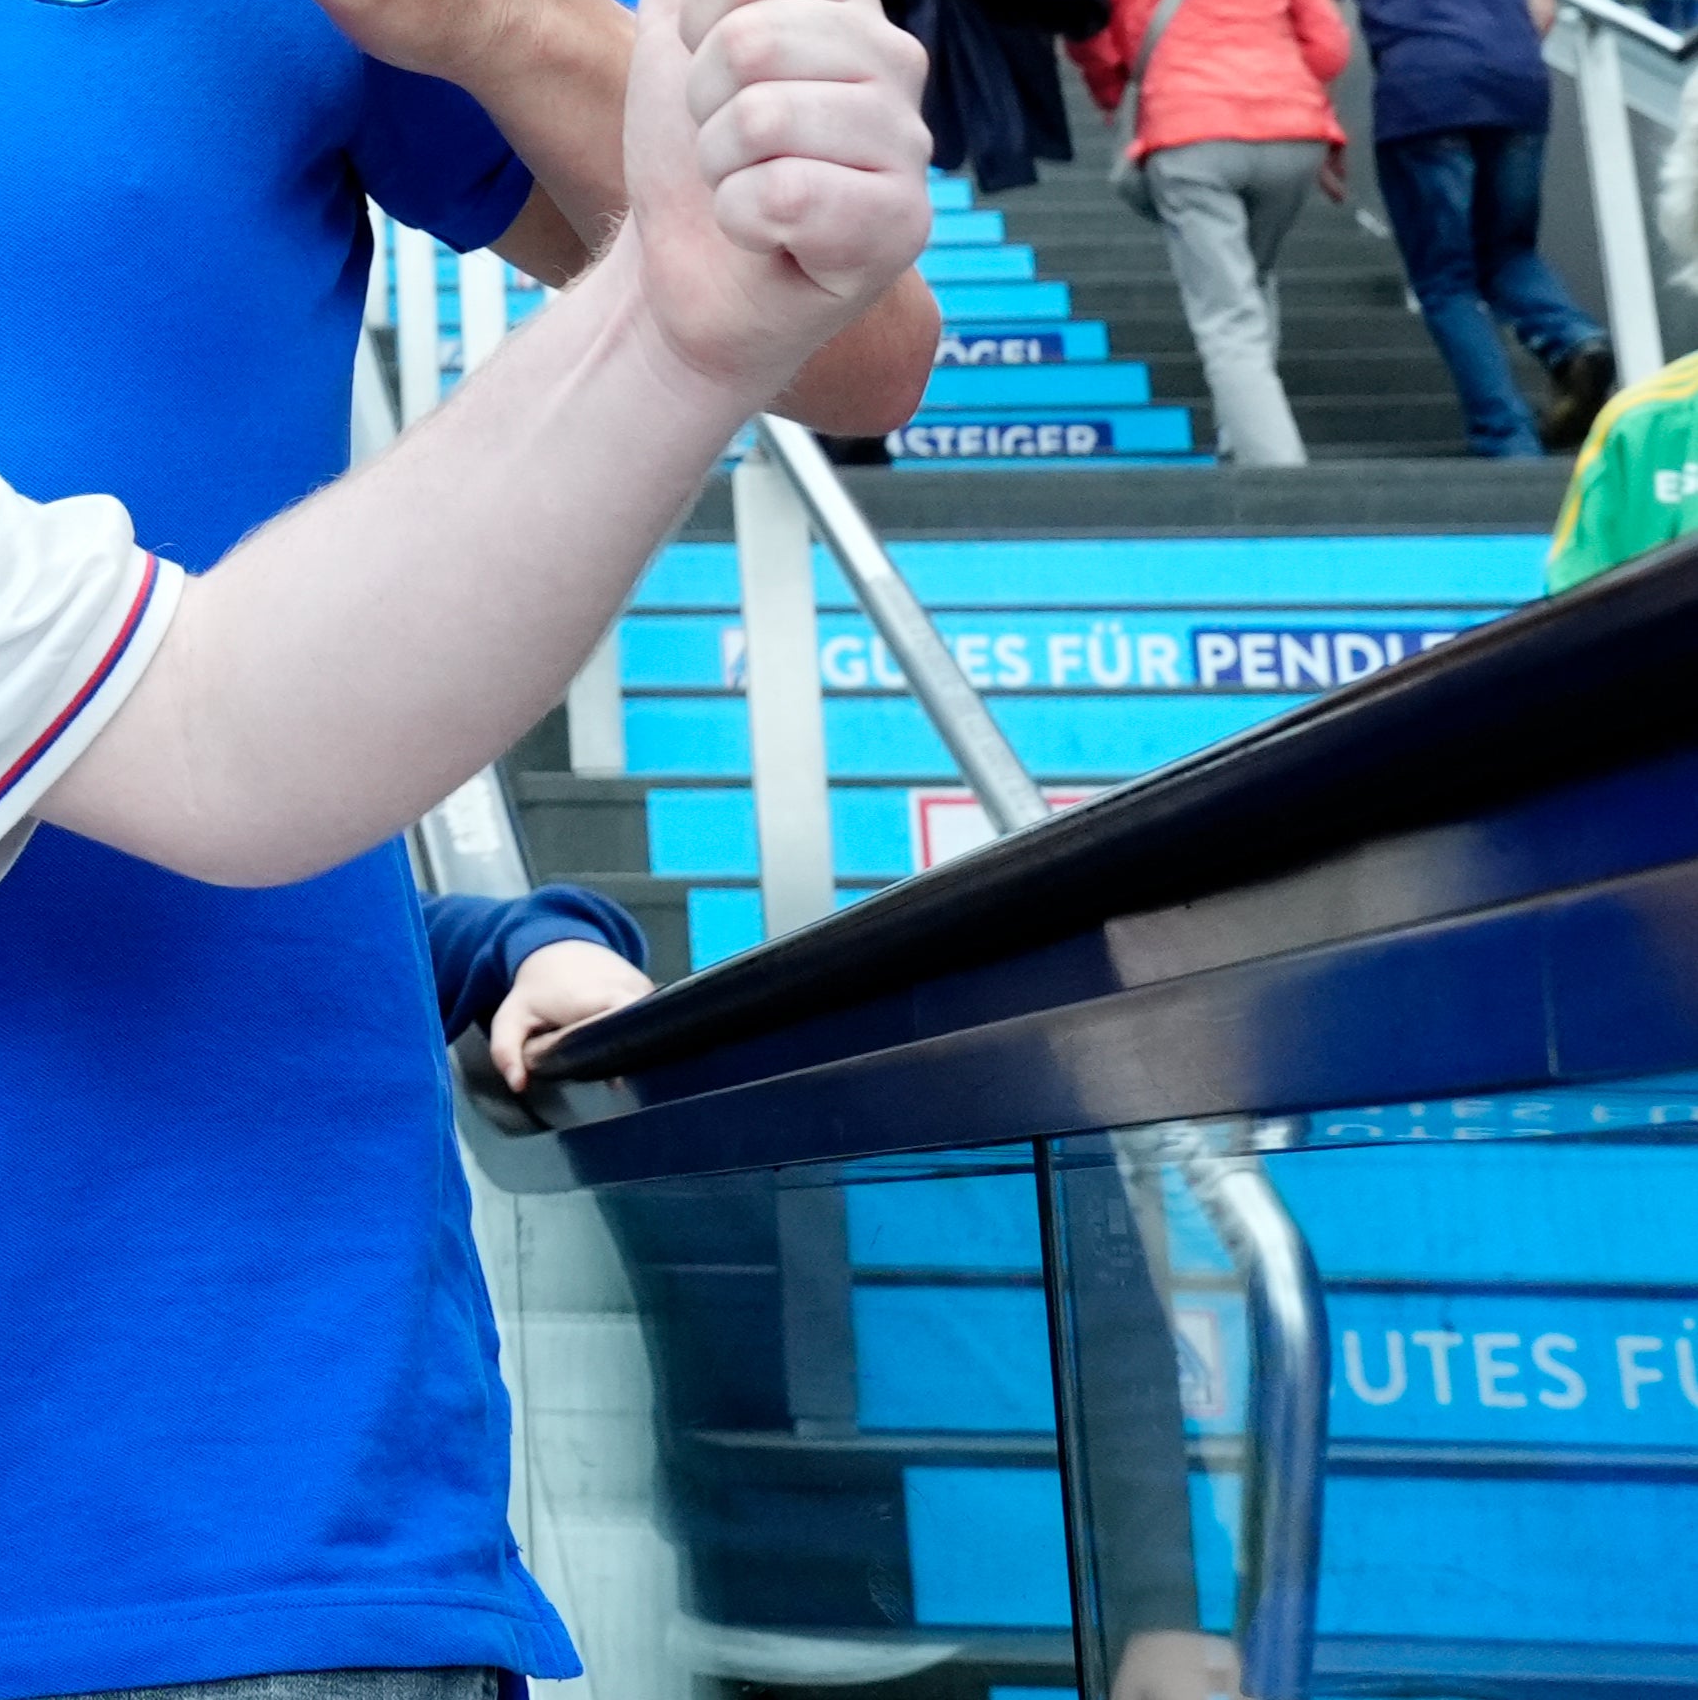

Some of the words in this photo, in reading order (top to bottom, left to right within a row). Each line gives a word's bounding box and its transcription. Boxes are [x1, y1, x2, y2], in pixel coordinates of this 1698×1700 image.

[821, 634, 1032, 689] GUES
[1047, 622, 1181, 688] FÜR
[1196, 632, 1458, 689] PEND
[1331, 1329, 1587, 1410] UTES
